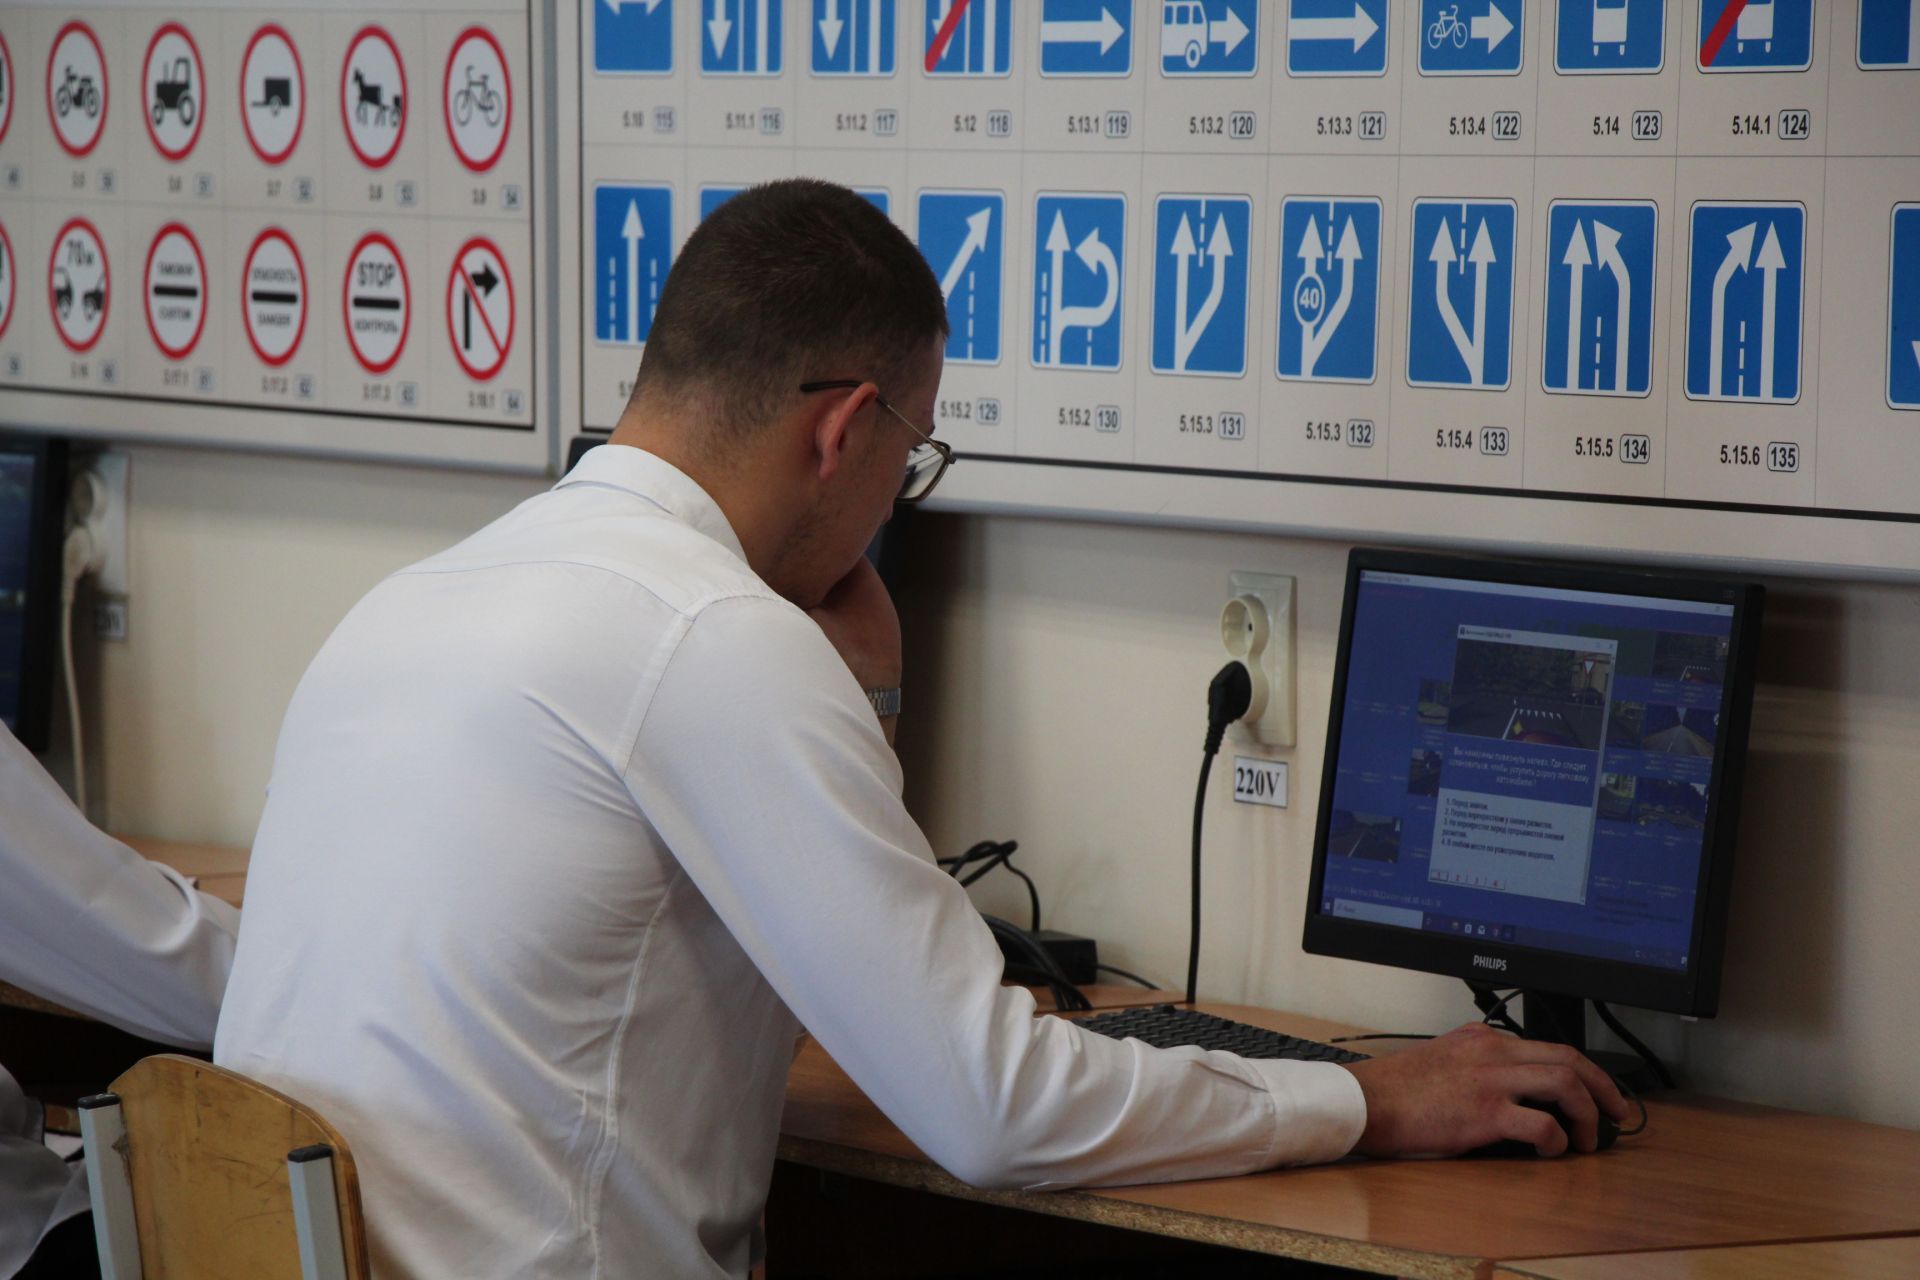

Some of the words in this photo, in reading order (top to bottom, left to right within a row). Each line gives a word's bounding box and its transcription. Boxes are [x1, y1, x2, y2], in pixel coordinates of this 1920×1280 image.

[656, 111, 673, 128] 115
[726, 112, 755, 129] 5.11.1
[763, 113, 780, 130] 116
[836, 114, 867, 131] 5.11.2
[877, 114, 895, 131] 117
[954, 115, 976, 132] 5.12
[990, 115, 1008, 133] 118
[1068, 116, 1099, 133] 5.13.1
[1108, 115, 1127, 134] 119
[1189, 116, 1223, 134] 5.13.2
[1232, 116, 1253, 134] 120
[1317, 116, 1352, 135] 5.13.3
[1361, 116, 1382, 135] 121
[1449, 117, 1485, 135] 5.13.4
[1495, 116, 1518, 135] 122
[1593, 116, 1619, 135] 5.14
[1635, 115, 1659, 136] 123
[1732, 115, 1771, 135] 5.14.1
[1782, 114, 1808, 135] 124
[359, 261, 396, 288] STOP
[1299, 288, 1320, 309] 40
[940, 401, 971, 419] 5.15.2
[979, 403, 998, 421] 129
[1059, 407, 1091, 426] 5.15.2
[1098, 410, 1118, 428] 130
[1179, 414, 1213, 434] 5.15.3
[1221, 416, 1241, 436] 131
[1306, 422, 1341, 441] 5.15.3
[1350, 424, 1371, 443] 132
[1436, 429, 1472, 449] 5.15.4
[1483, 431, 1506, 451] 133
[1575, 437, 1613, 457] 5.15.5
[1624, 439, 1647, 459] 134
[1720, 445, 1760, 465] 5.15.6
[1771, 446, 1796, 467] 135
[1236, 767, 1280, 798] 220V
[1472, 954, 1507, 971] PHILIPS
